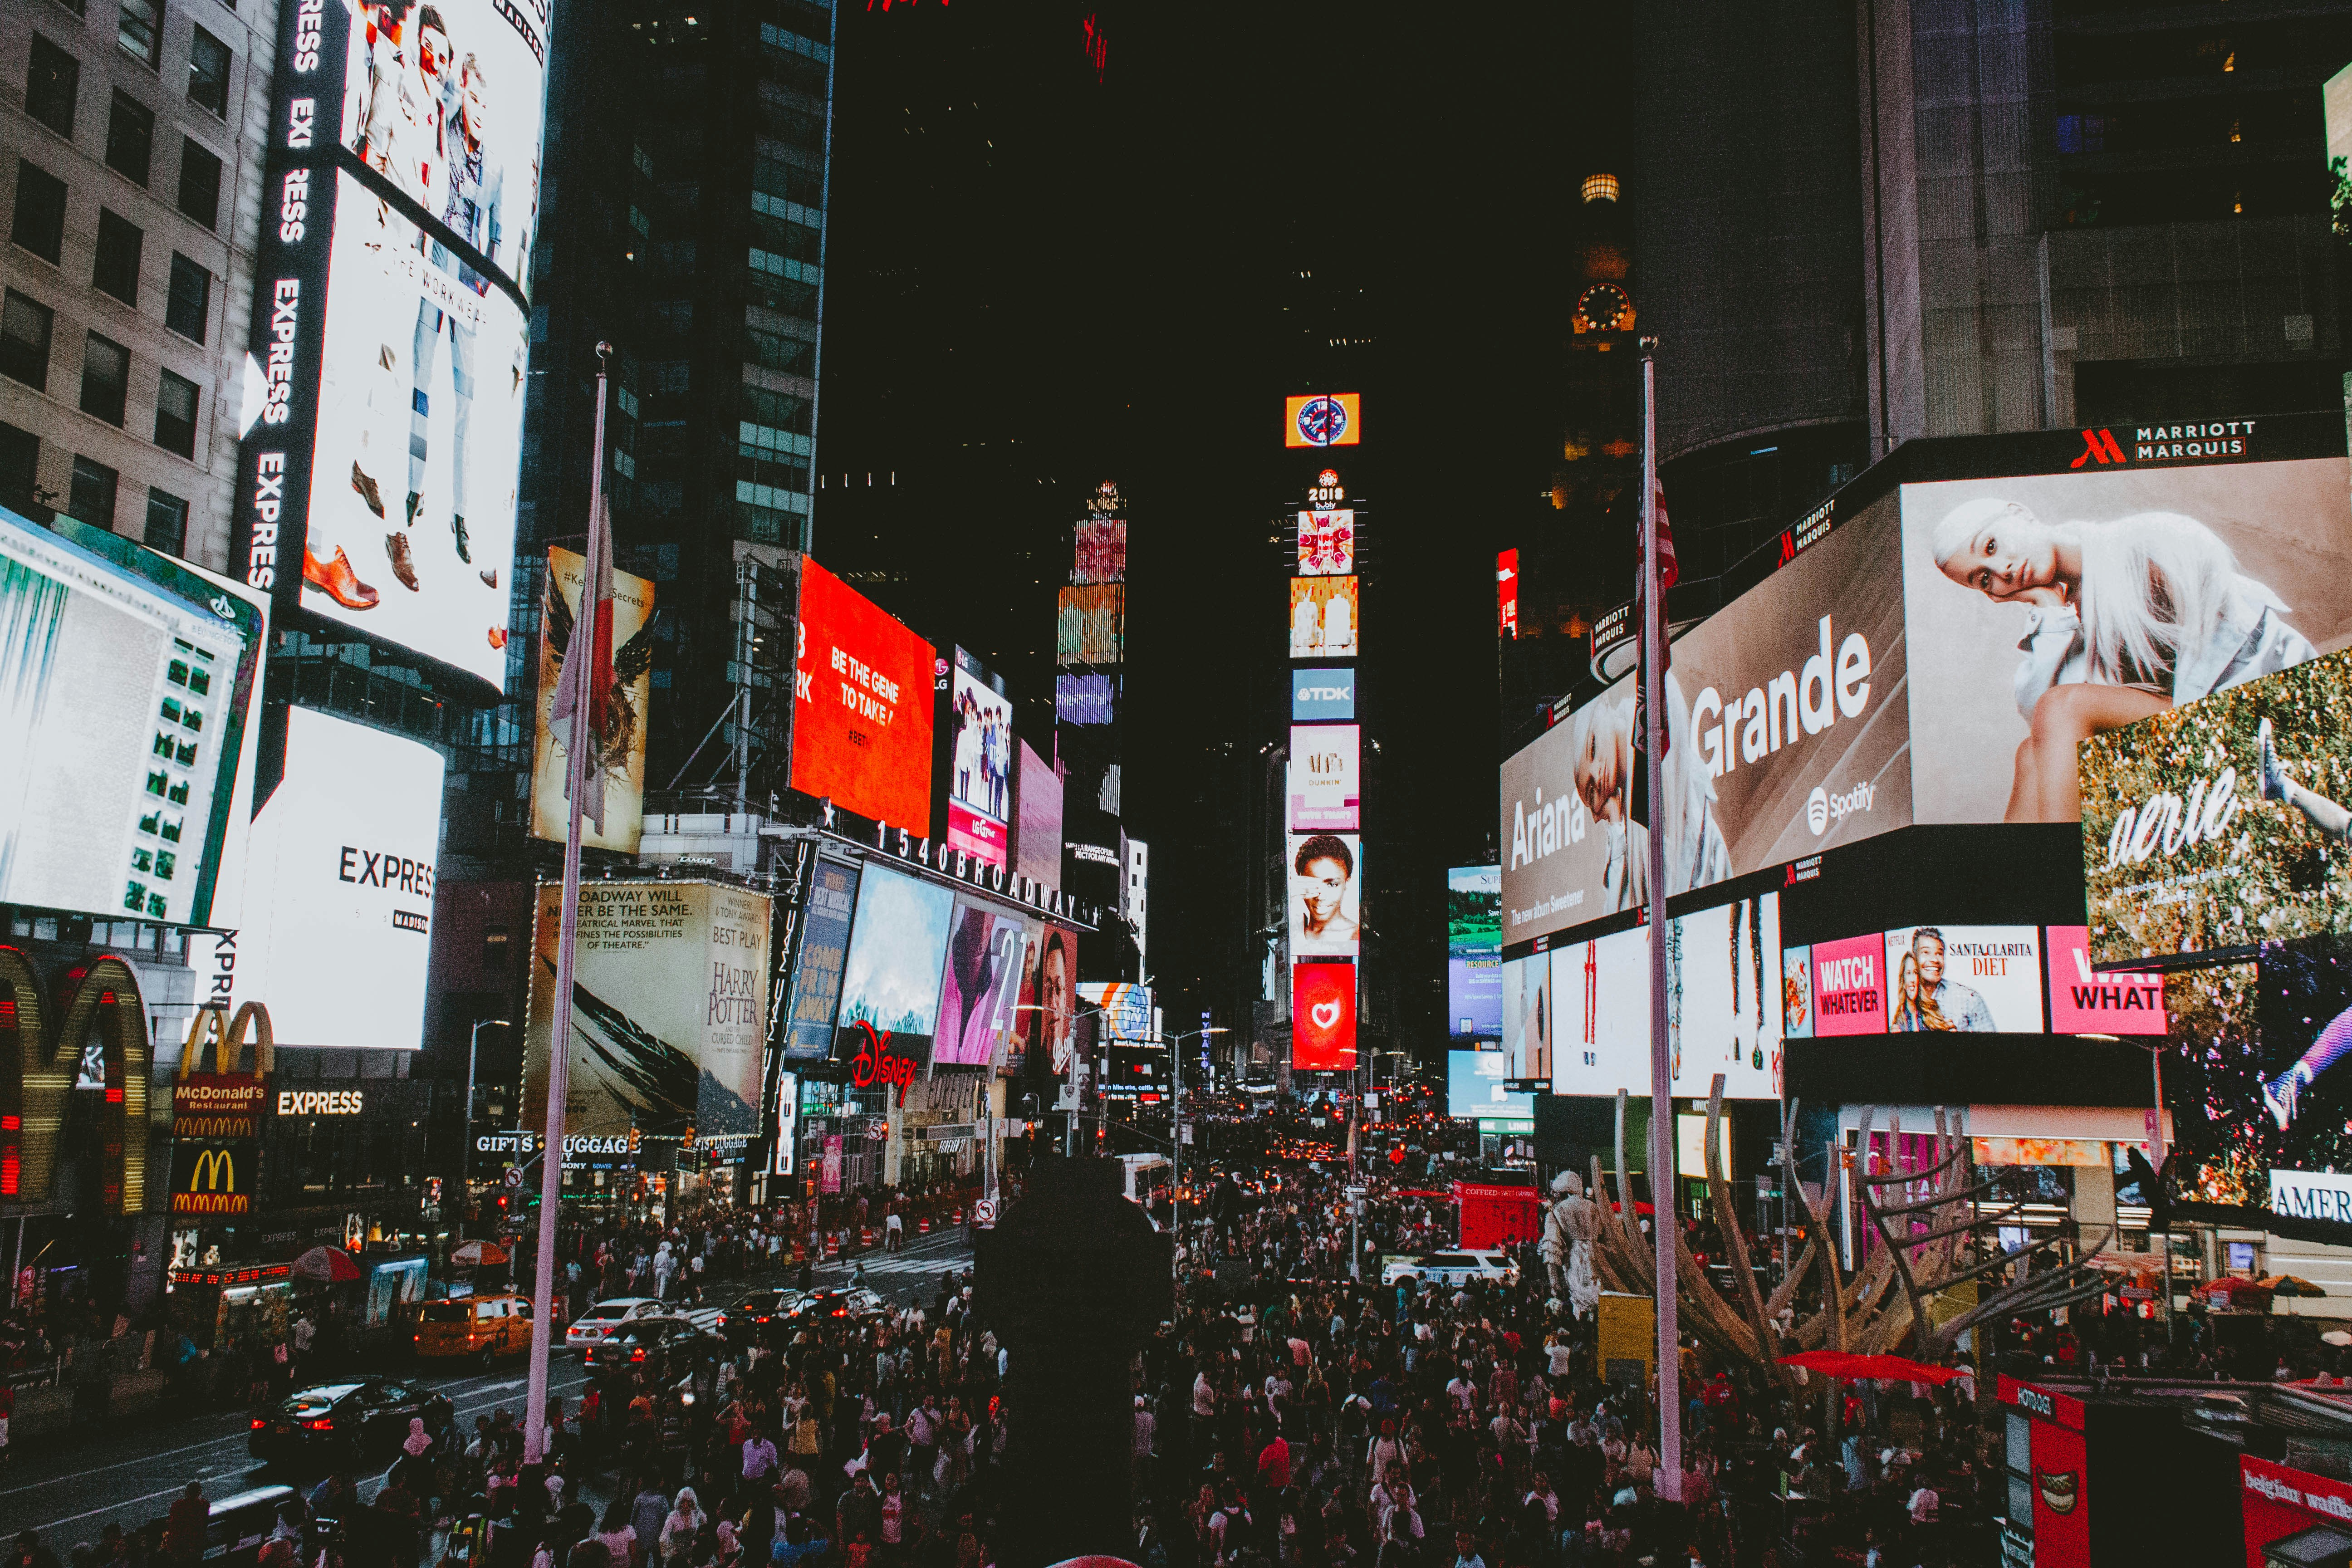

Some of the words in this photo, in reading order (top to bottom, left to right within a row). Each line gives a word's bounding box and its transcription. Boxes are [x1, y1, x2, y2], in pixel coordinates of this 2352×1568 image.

[264, 279, 299, 424] EXPRESS
[2136, 421, 2255, 441] MARRIOTT
[2137, 440, 2242, 459] MARQUIS
[1308, 487, 1343, 501] 2018
[1796, 499, 1835, 535] MARRIOTT
[1797, 519, 1831, 550] MARQUIS
[612, 588, 645, 608] Secrets
[1595, 606, 1629, 634] MARRIOTT
[1595, 623, 1624, 649] MARQUIS
[831, 646, 847, 675] BE
[848, 656, 870, 688] THE
[871, 671, 899, 704] GENE
[841, 682, 857, 710] TO
[858, 691, 886, 727] TAKE
[1309, 686, 1351, 701] TDK
[1690, 614, 1872, 781] Grande
[1829, 781, 1876, 821] Spotify
[2109, 749, 2238, 868] aerie
[1510, 786, 1585, 872] Ariana
[1796, 856, 1823, 870] MARRIOTT
[1796, 867, 1820, 881] MARQUIS
[557, 891, 643, 902] “OADWAY
[647, 890, 683, 902] WILL
[956, 853, 1075, 919] BROADWAY
[547, 904, 593, 917] NER
[597, 905, 615, 917] BE
[619, 904, 647, 916] THE
[651, 904, 692, 916] SAME.
[1511, 909, 1522, 926] The
[1521, 907, 1534, 922] new
[1533, 900, 1549, 918] album
[1550, 888, 1584, 913] Sweetener
[553, 930, 600, 939] RFINES
[603, 930, 621, 939] THE
[623, 930, 682, 939] POSSIBILITIES
[576, 919, 618, 928] EATRICAL
[621, 919, 657, 927] MARVEL
[659, 918, 685, 927] THAT
[587, 941, 600, 949] OF
[713, 926, 737, 946] BEST
[739, 931, 762, 950] PLAY
[1887, 935, 1906, 948] NETFLIX
[1949, 943, 1983, 956] SANTA
[1986, 943, 2033, 956] CLARITA
[805, 943, 843, 972] COME
[1972, 957, 2008, 976] DIET
[712, 961, 759, 998] HARRY
[990, 928, 1028, 1032] 21
[1820, 955, 1874, 992] WATCH
[707, 991, 760, 1026] POTTER
[794, 995, 836, 1023] AWAY
[1820, 989, 1879, 1016] WHATEVER
[2072, 986, 2160, 1011] WHAT
[712, 1032, 734, 1044] CURSED
[735, 1034, 753, 1046] CHILD
[176, 1086, 264, 1100] McDonald's
[277, 1090, 363, 1116] EXPRESS
[189, 1102, 247, 1110] Restaurant
[476, 1136, 533, 1152] GIFTS
[562, 1137, 642, 1155] UGGAGE
[938, 1138, 960, 1155] FOREVER
[2244, 1469, 2303, 1506] belgian
